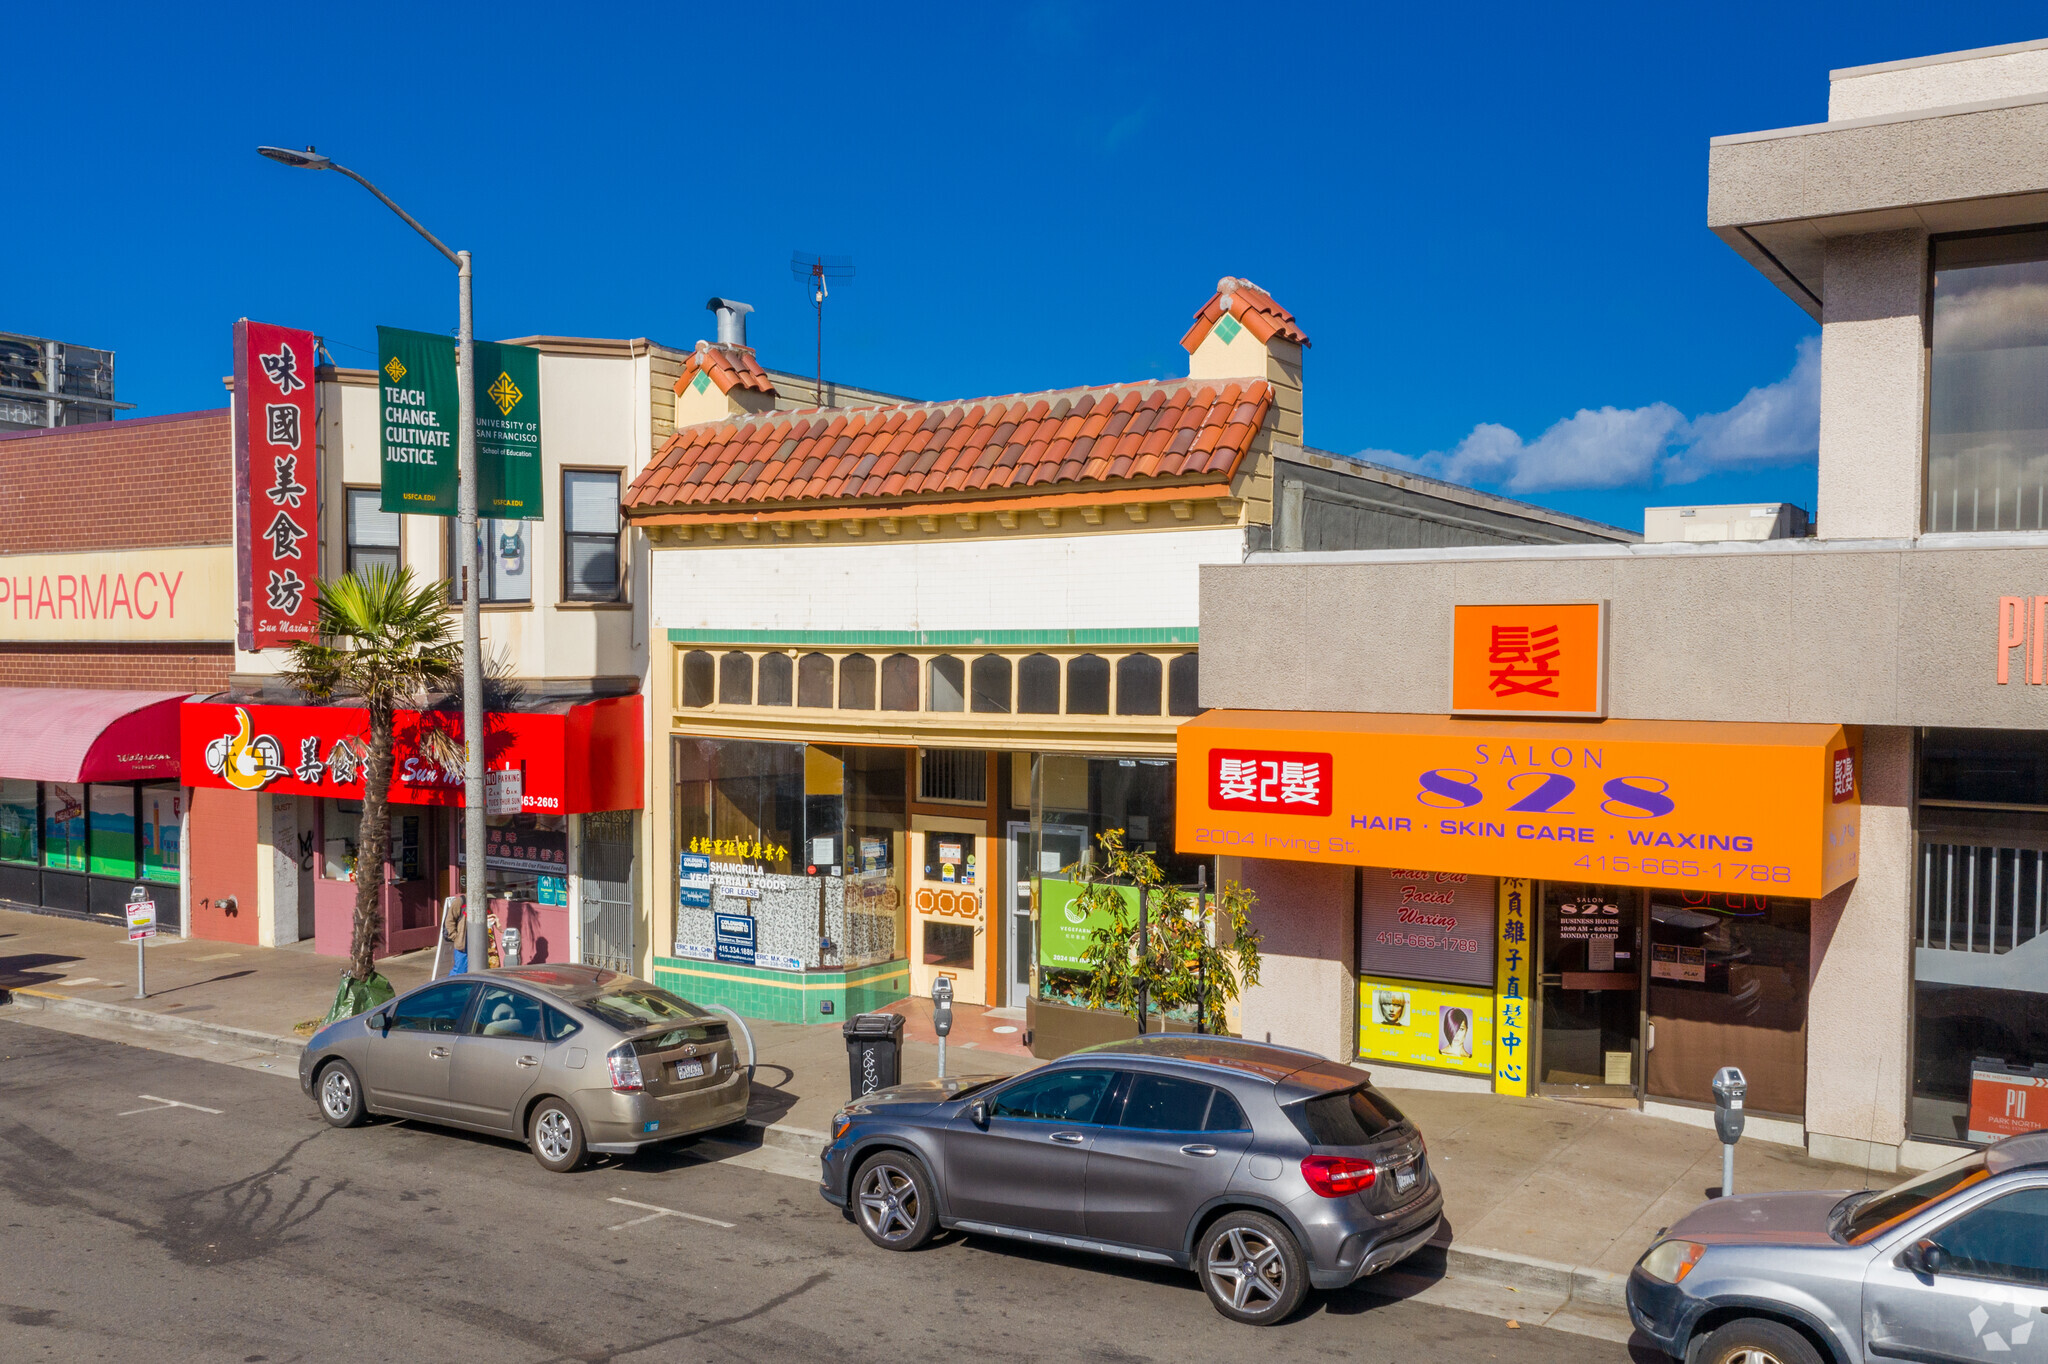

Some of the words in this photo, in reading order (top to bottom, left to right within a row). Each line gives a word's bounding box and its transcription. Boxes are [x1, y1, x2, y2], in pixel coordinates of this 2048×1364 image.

[385, 387, 425, 406] TEACH
[385, 407, 440, 427] CHANGE.
[476, 418, 524, 430] UNIVERSITY
[526, 423, 537, 431] OF
[386, 427, 450, 447] CULTIVATE
[476, 429, 491, 438] SAN
[493, 431, 538, 443] FRANCISCO
[386, 446, 438, 465] JUSTICE.
[482, 447, 499, 455] School
[500, 448, 506, 456] of
[506, 449, 532, 457] Education
[258, 341, 307, 617] 味國美食坊
[403, 493, 436, 501] USFCA.EDU
[493, 499, 523, 507] USFCA.EDU
[258, 619, 277, 632] Sun
[1488, 624, 1560, 698] 髮
[1475, 744, 1603, 769] SALON
[401, 757, 438, 782] Sun
[486, 772, 496, 785] NO
[497, 773, 520, 783] PARKING
[505, 786, 511, 795] 6
[1416, 768, 1675, 819] 828
[1196, 828, 1255, 846] 2004
[1264, 833, 1321, 854] Irving
[1329, 837, 1361, 854] St.
[1350, 814, 1412, 832] HAIR
[1440, 820, 1505, 838] SKIN
[1516, 824, 1595, 843] CARE
[1627, 830, 1753, 852] WAXING
[710, 861, 764, 876] SHANGRILA
[1573, 854, 1791, 883] 415-665-1788
[690, 872, 748, 888] VEGETARIAN
[751, 878, 787, 890] FOODS
[721, 886, 734, 895] FOR
[737, 888, 758, 897] LEASE
[1400, 884, 1455, 905] Facial
[1560, 903, 1619, 915] 828
[1397, 906, 1459, 932] Waxing
[677, 943, 688, 951] ERIC
[1376, 931, 1478, 953] 415-665-1788
[756, 953, 769, 961] ERIC
[1053, 954, 1068, 962] 2024
[1988, 1115, 2009, 1125] PARK
[2011, 1119, 2041, 1128] NORTH
